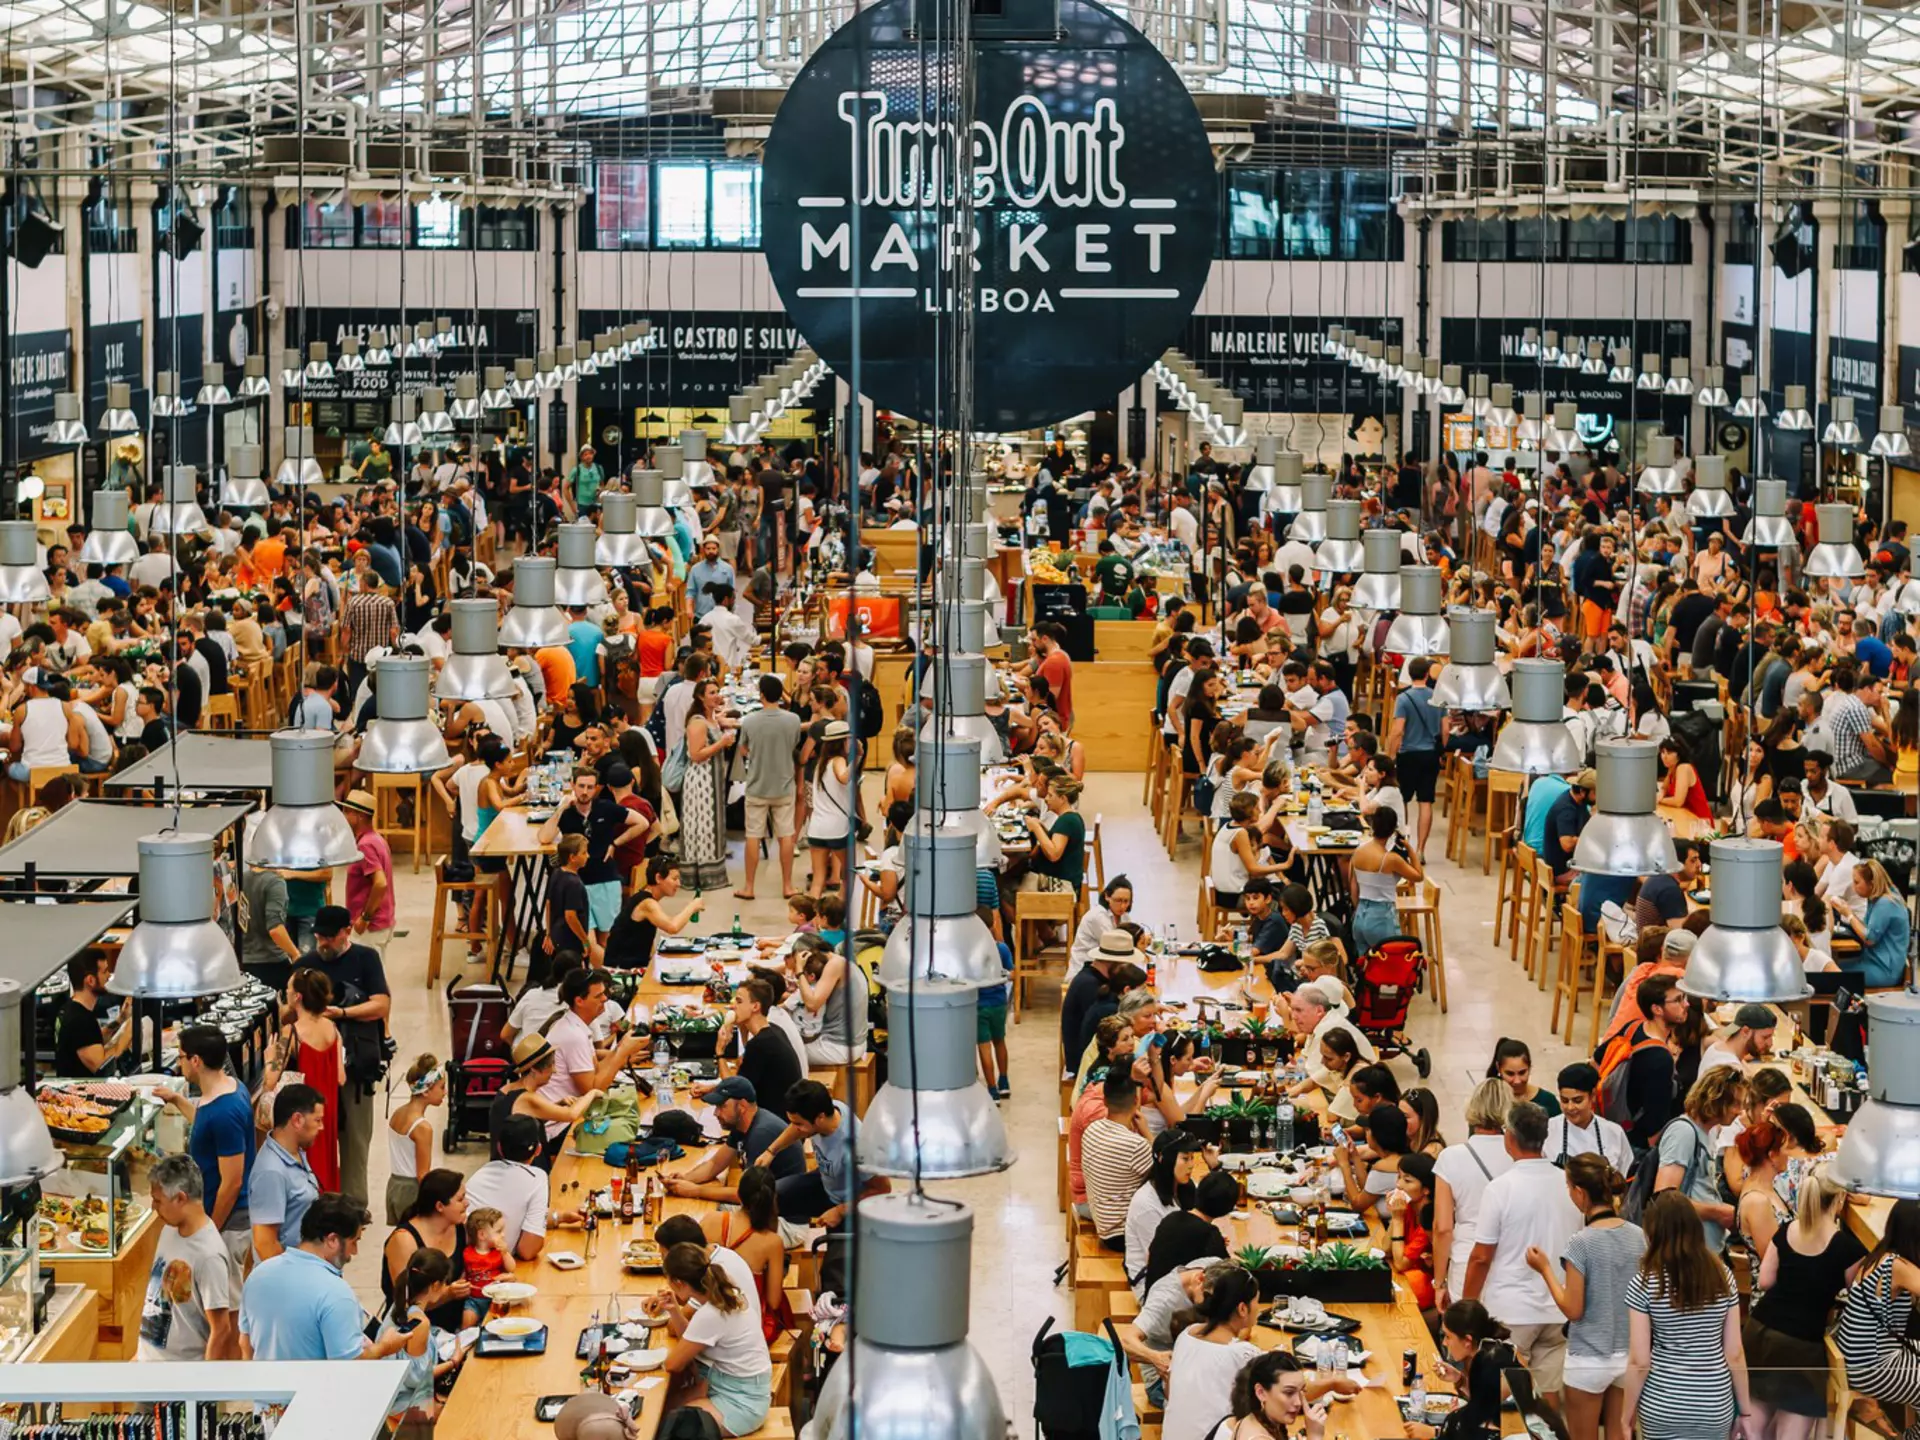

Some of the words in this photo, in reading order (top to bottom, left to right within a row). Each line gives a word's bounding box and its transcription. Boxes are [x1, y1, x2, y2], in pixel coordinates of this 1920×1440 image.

[801, 222, 1177, 272] MARKET
[673, 326, 738, 349] CASTRO
[744, 328, 754, 349] E
[1210, 331, 1287, 354] MARLENE
[352, 378, 389, 389] FOOD
[600, 382, 668, 391] SIMPLY
[682, 383, 742, 392] PORTU
